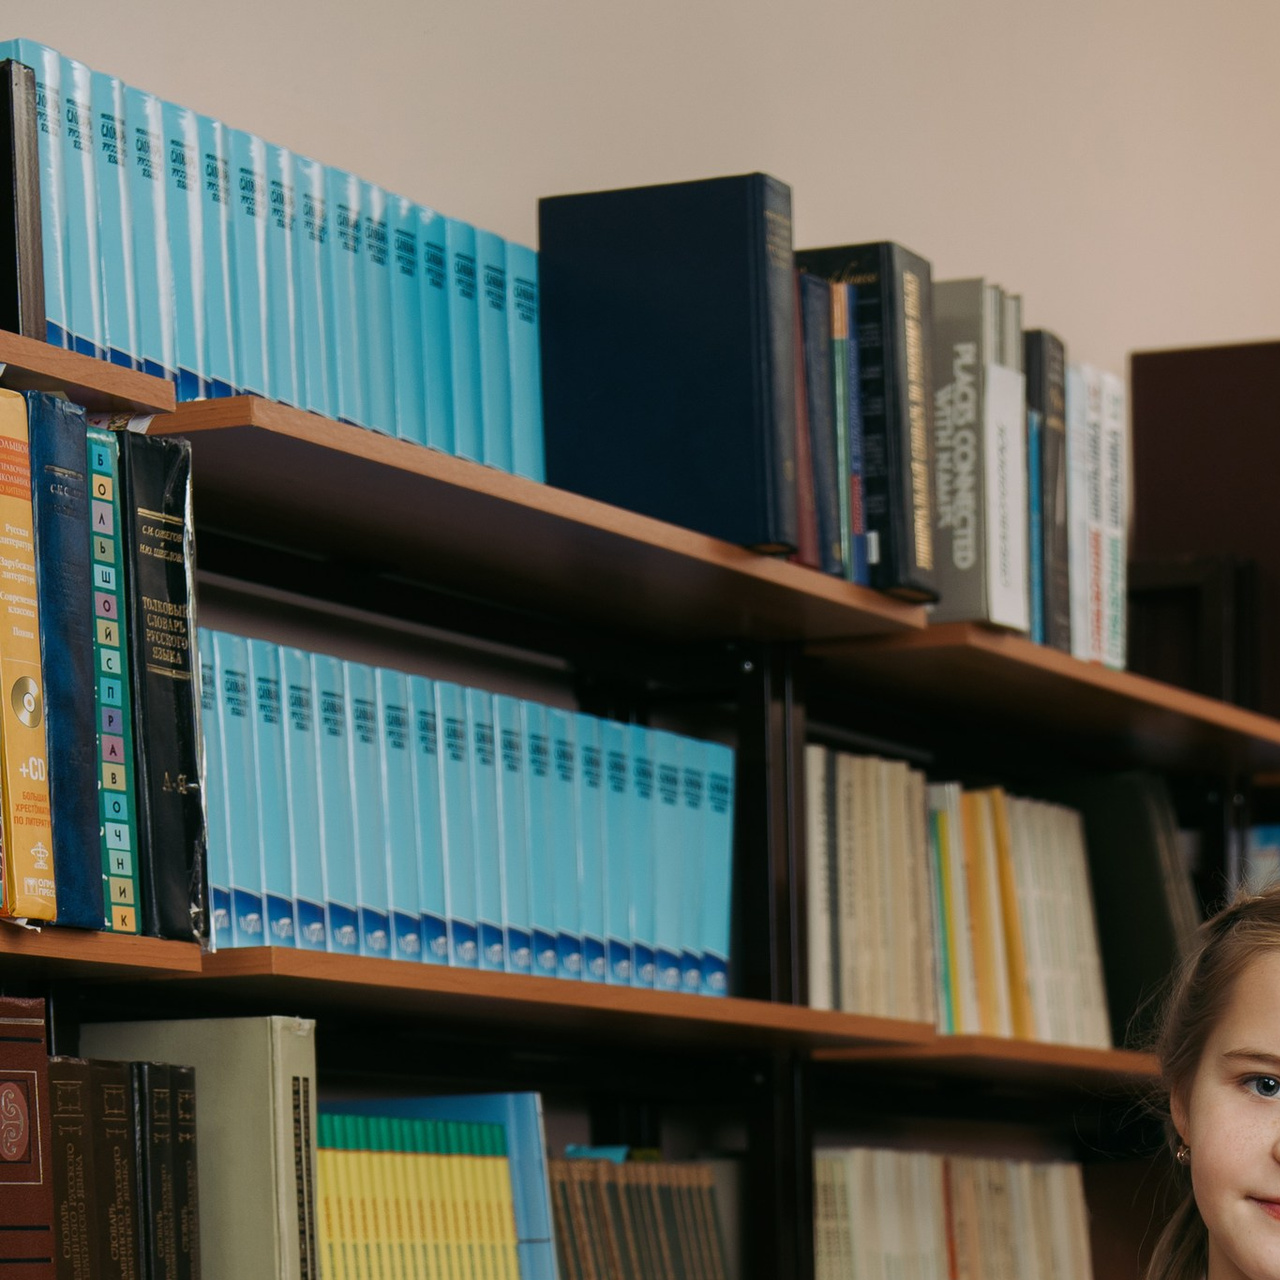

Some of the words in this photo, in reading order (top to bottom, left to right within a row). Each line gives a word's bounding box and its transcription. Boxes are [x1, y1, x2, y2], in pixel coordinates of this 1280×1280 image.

[952, 342, 977, 427] PLACES
[952, 428, 977, 571] CONNECTED
[154, 528, 183, 543] ОЖЕГОВ
[146, 627, 188, 650] РУССКОГО
[147, 612, 186, 633] СЛОВАРЬ
[152, 646, 182, 665] ЯЗЫКА
[19, 756, 46, 782] +CD
[106, 658, 128, 927] СПРАВОЧНИК
[13, 815, 24, 826] ПО
[66, 1142, 77, 1207] РУССКОГО
[60, 1200, 72, 1259] СЛОВАРЬ
[108, 1203, 119, 1261] СЛОВАРЬ
